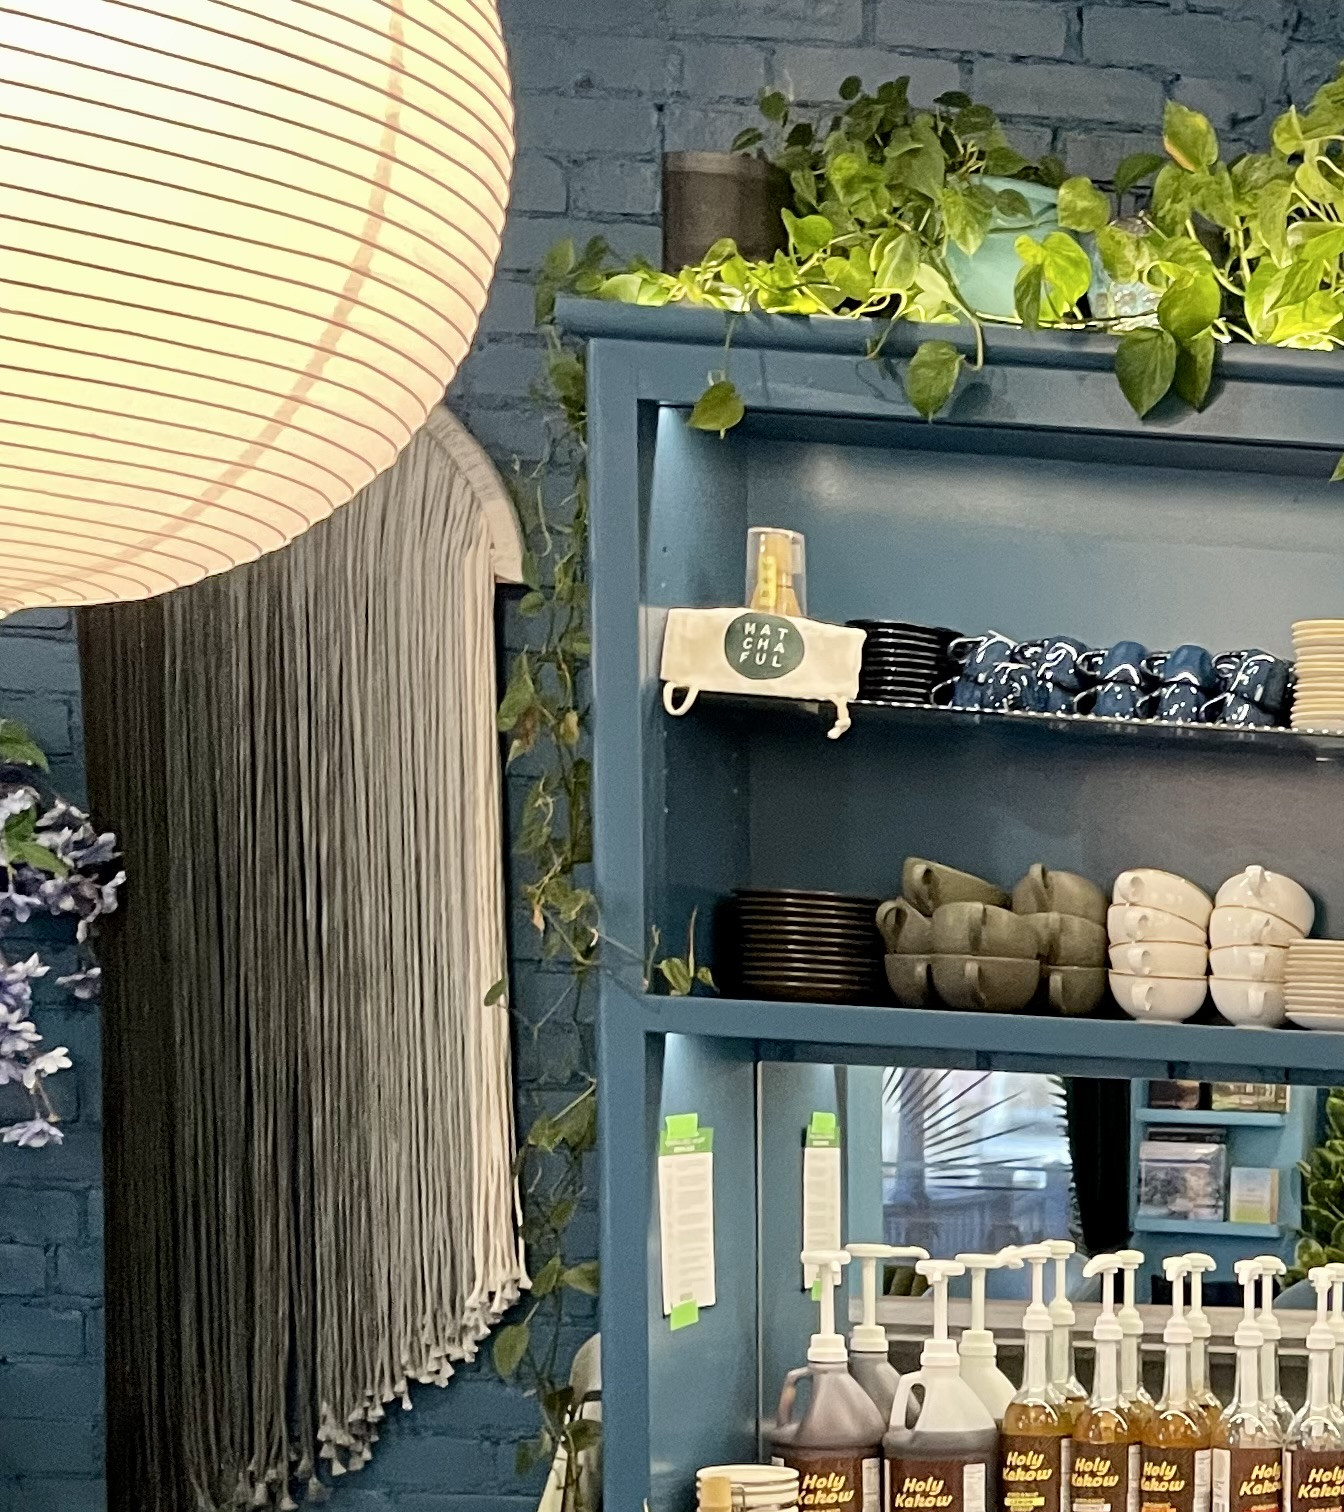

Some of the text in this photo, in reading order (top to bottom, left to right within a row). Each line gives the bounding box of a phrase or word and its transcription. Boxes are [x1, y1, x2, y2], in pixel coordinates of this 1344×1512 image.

[739, 652, 782, 668] FUL
[1006, 1451, 1045, 1470] Holy
[1074, 1457, 1111, 1476] Holy
[1143, 1460, 1177, 1480] Holy
[802, 1472, 846, 1490] Holy
[902, 1476, 945, 1494] Holy
[1239, 1480, 1282, 1496] Kako
